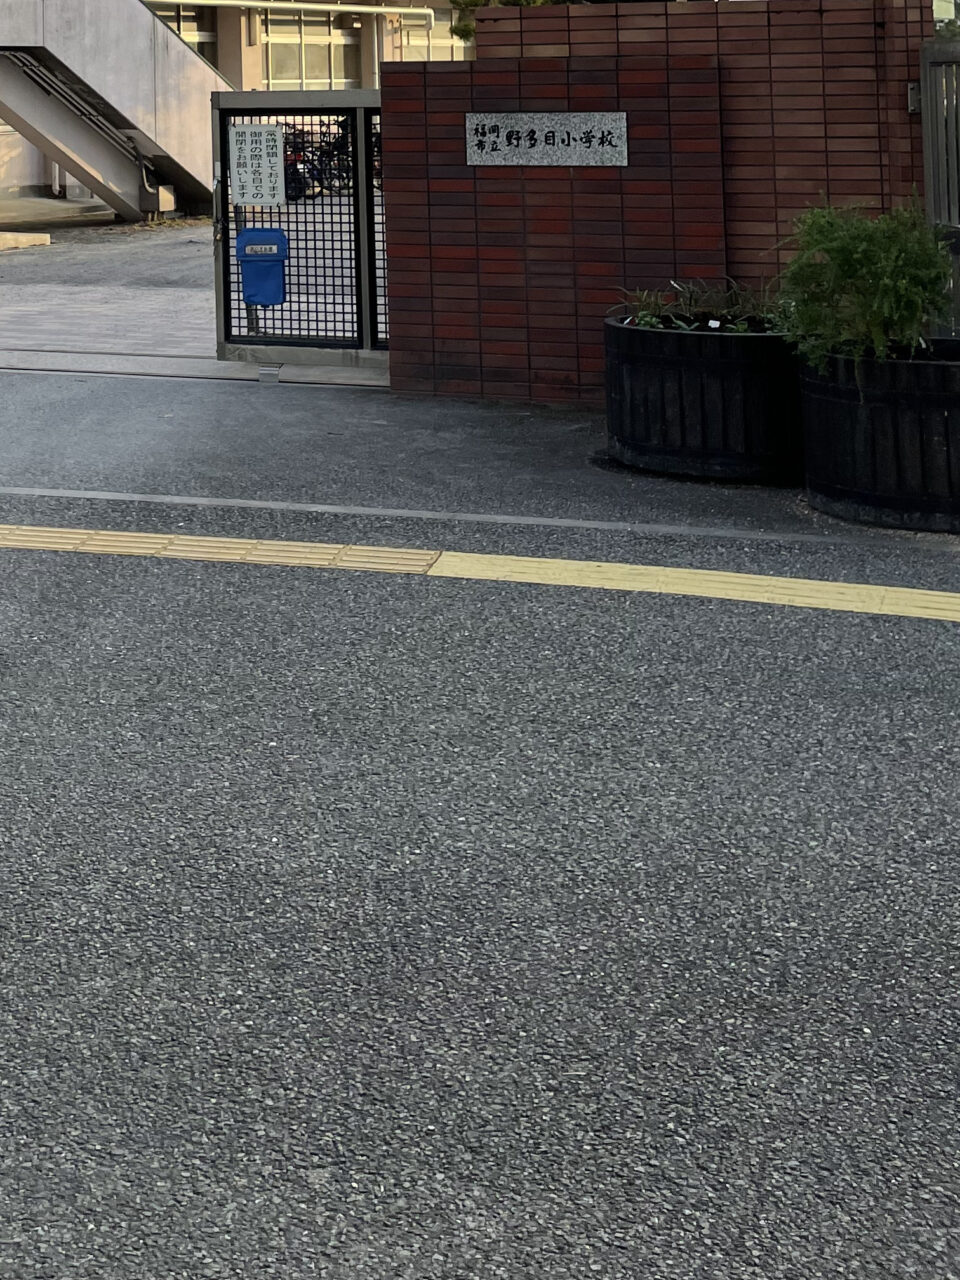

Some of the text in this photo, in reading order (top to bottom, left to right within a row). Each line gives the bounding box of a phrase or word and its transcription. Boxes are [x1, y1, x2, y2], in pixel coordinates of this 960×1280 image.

[473, 123, 500, 138] 福岡
[475, 139, 502, 153] 市立
[505, 128, 619, 150] 野多目小学校
[235, 131, 248, 199] 開閉をお願いします
[250, 131, 264, 199] 御用の際は各自での
[265, 130, 279, 199] 常時閉鎖しております
